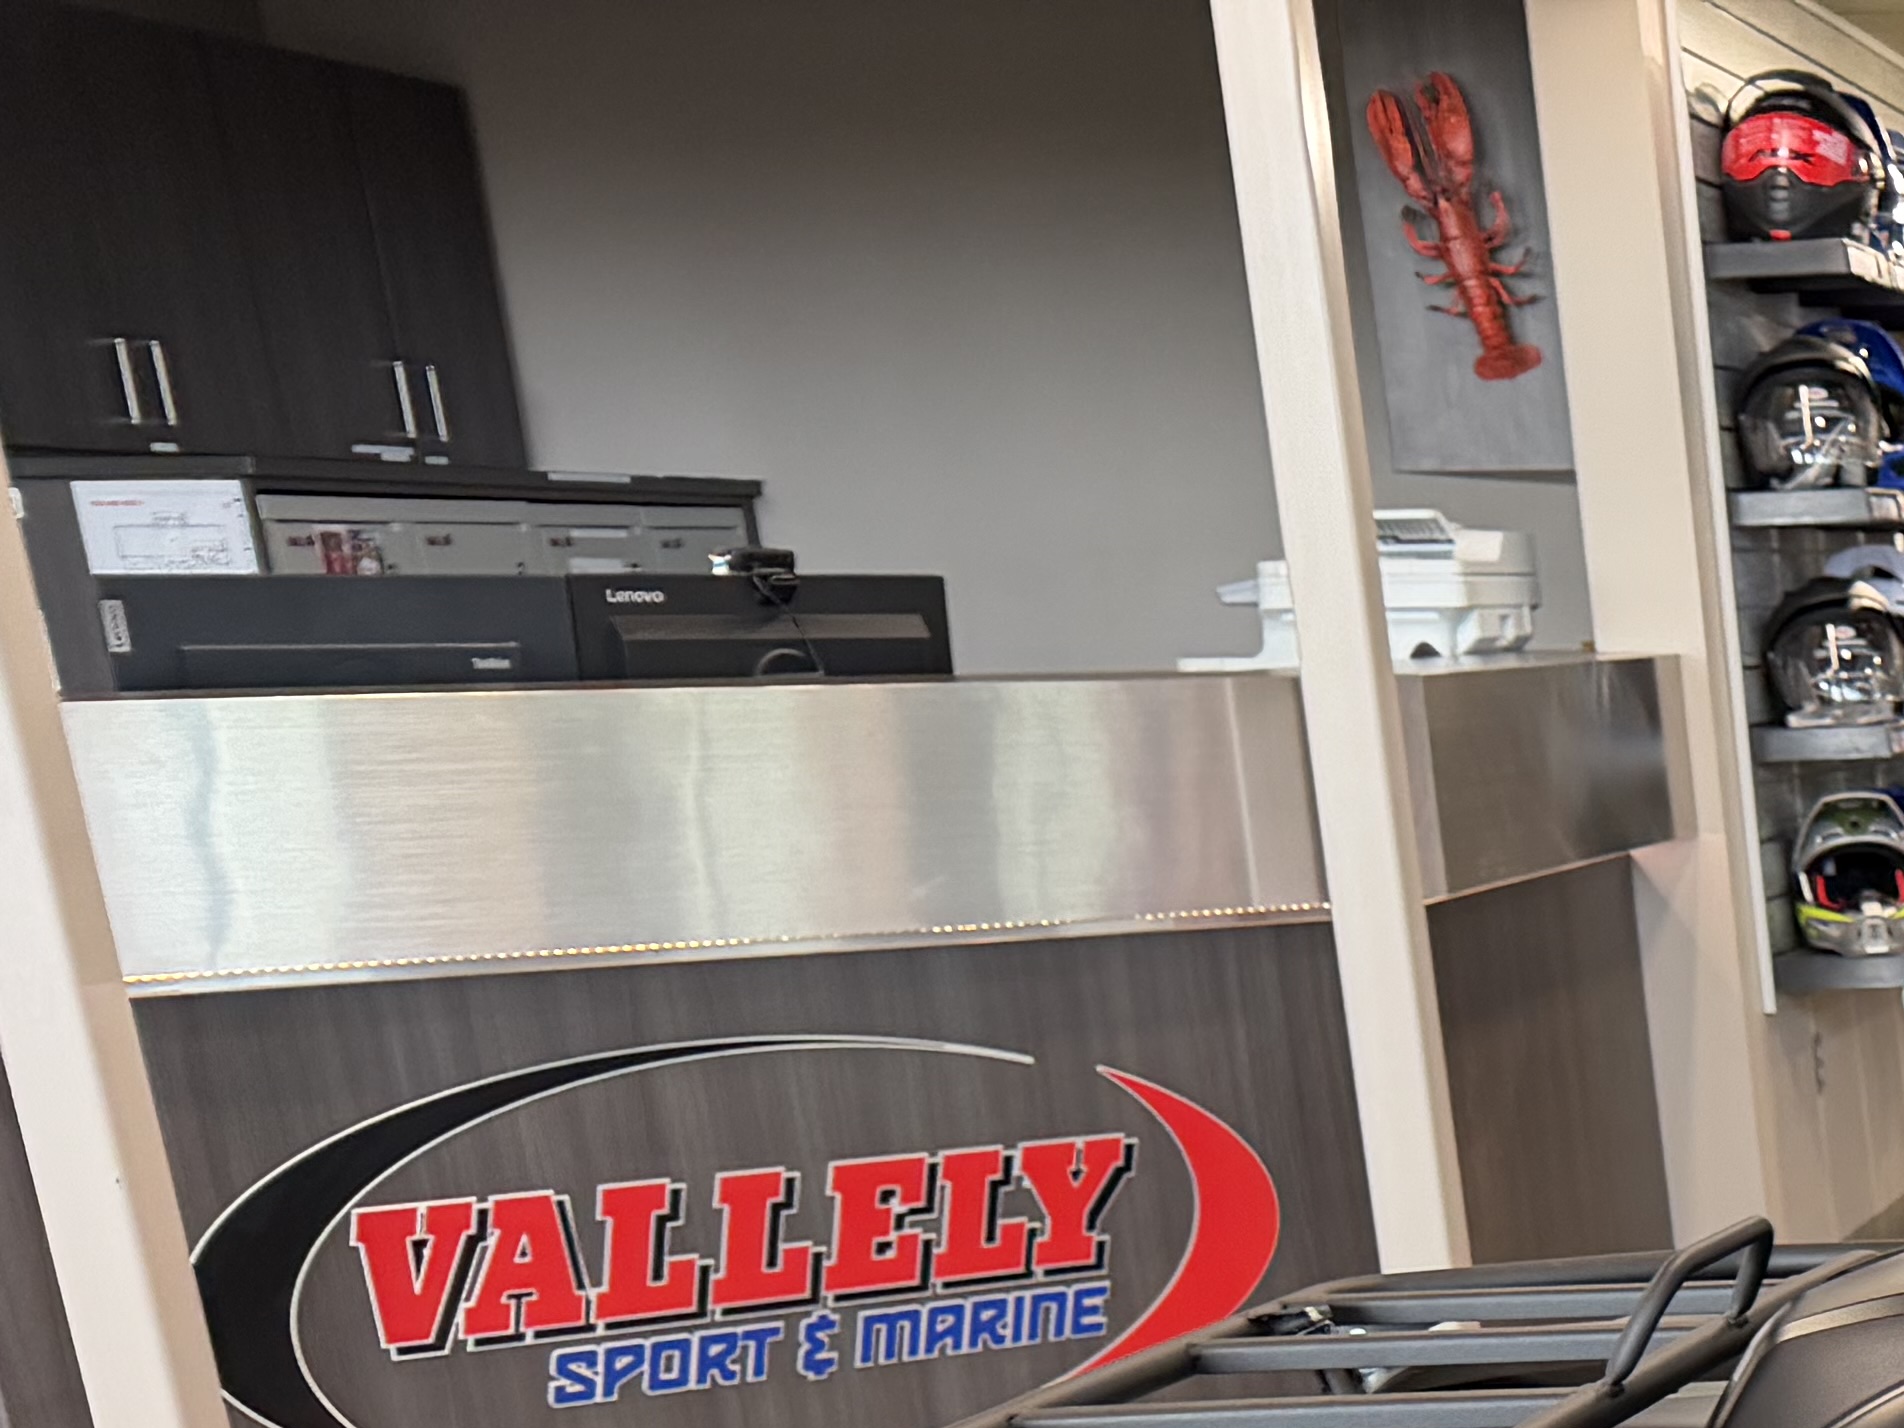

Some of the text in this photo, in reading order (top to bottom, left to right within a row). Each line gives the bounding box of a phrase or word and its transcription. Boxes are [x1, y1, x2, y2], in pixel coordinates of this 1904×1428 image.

[605, 588, 664, 604] Lenovo
[350, 1133, 1138, 1359] VALLELY
[548, 1282, 1111, 1407] SPORT & MARINE
